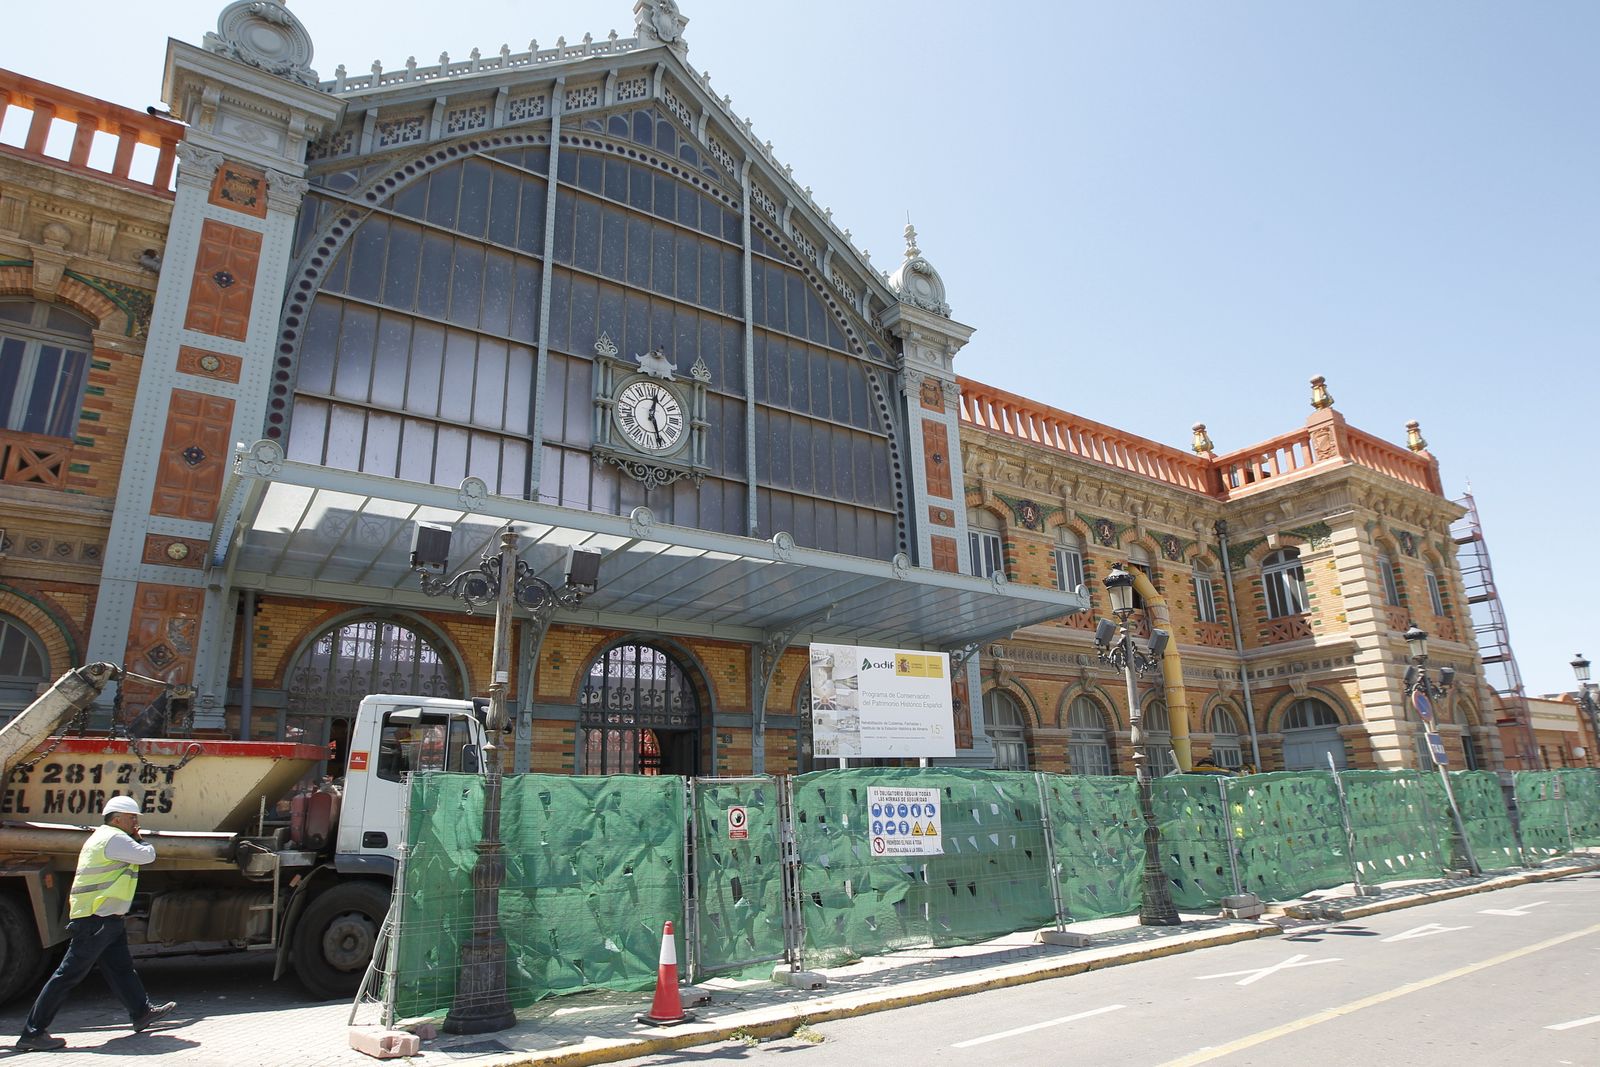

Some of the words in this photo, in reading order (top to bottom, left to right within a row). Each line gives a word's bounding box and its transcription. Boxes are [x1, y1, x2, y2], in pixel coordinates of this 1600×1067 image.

[873, 661, 894, 669] adif
[896, 692, 930, 700] Conservación
[872, 700, 899, 708] Patrimonio
[42, 763, 104, 784] 281
[44, 788, 174, 813] MORES
